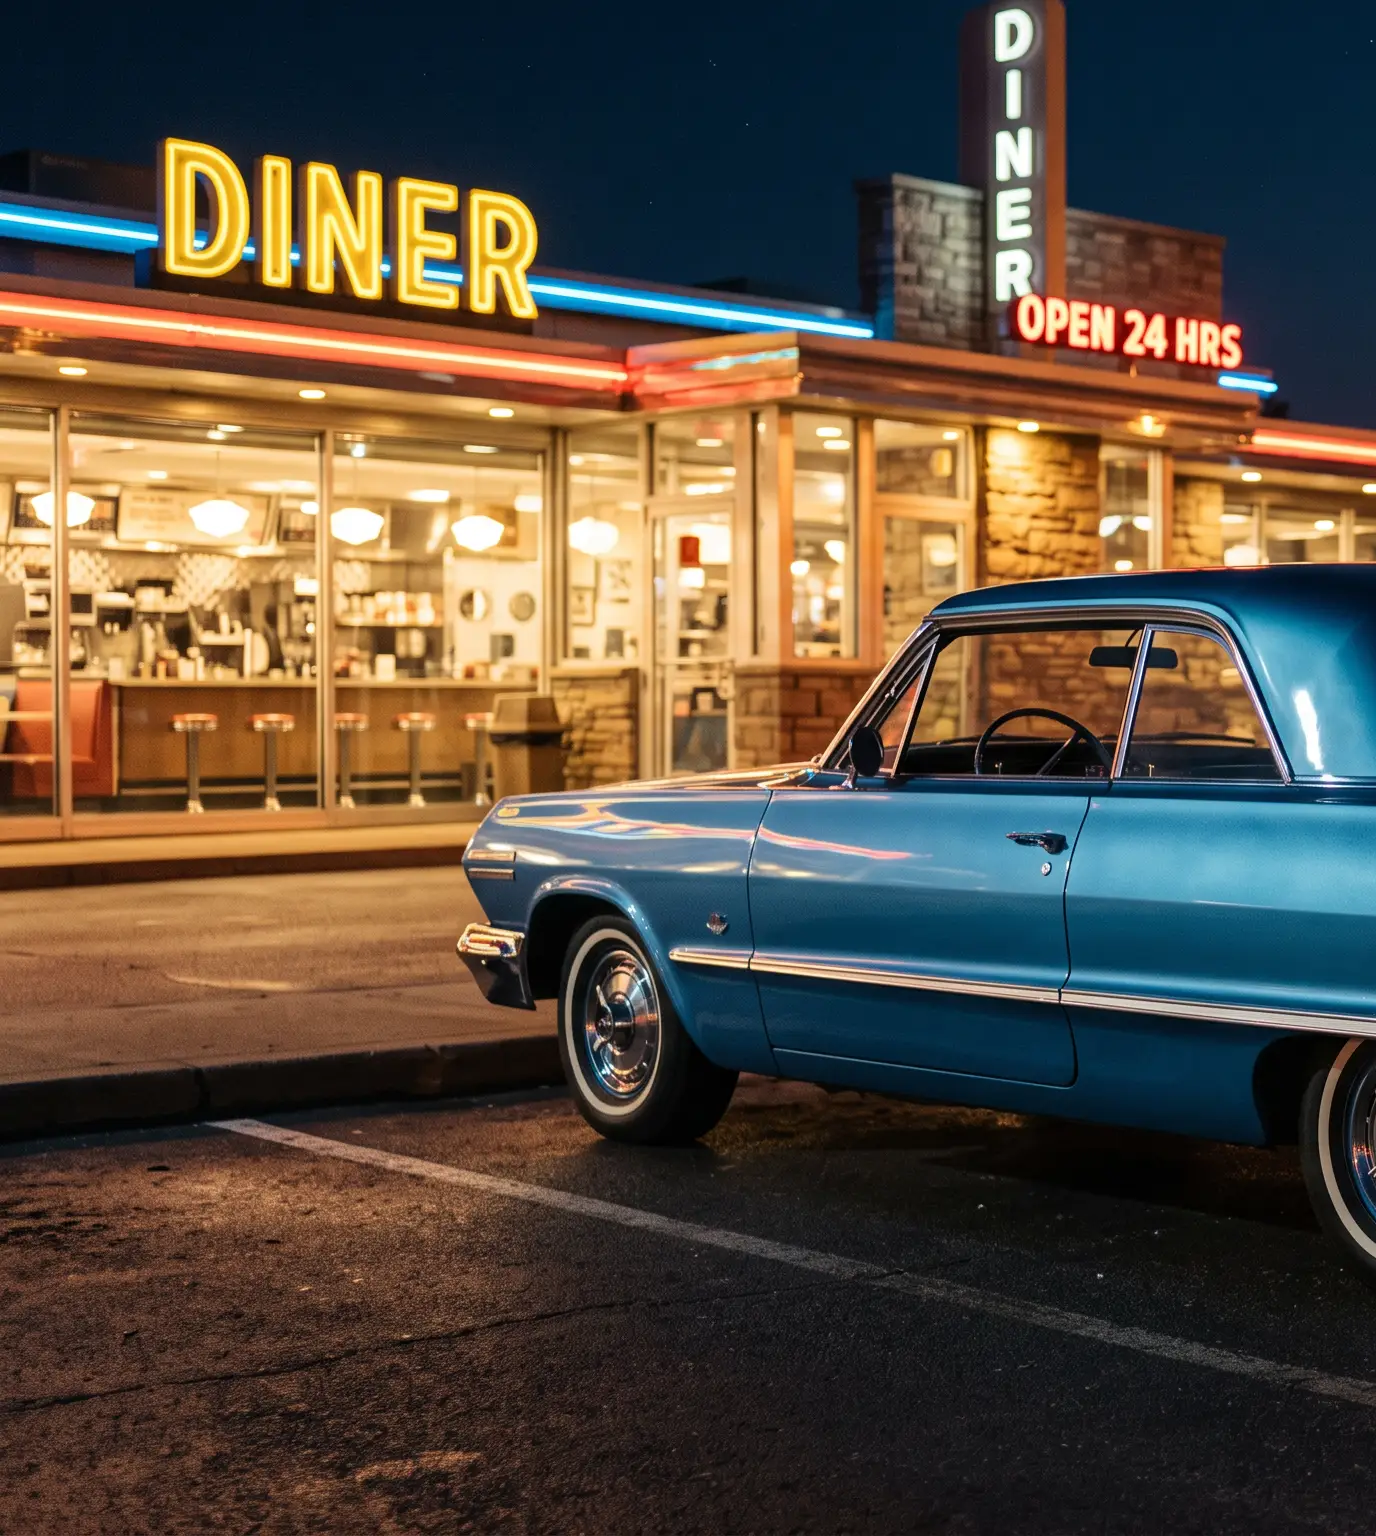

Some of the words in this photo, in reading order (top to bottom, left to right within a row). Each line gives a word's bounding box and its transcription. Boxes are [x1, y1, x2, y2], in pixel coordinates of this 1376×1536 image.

[163, 137, 539, 320] DINER
[995, 8, 1033, 302] DINER
[1016, 293, 1115, 352] OPEN
[1122, 308, 1168, 359] 24
[1175, 316, 1243, 370] HRS
